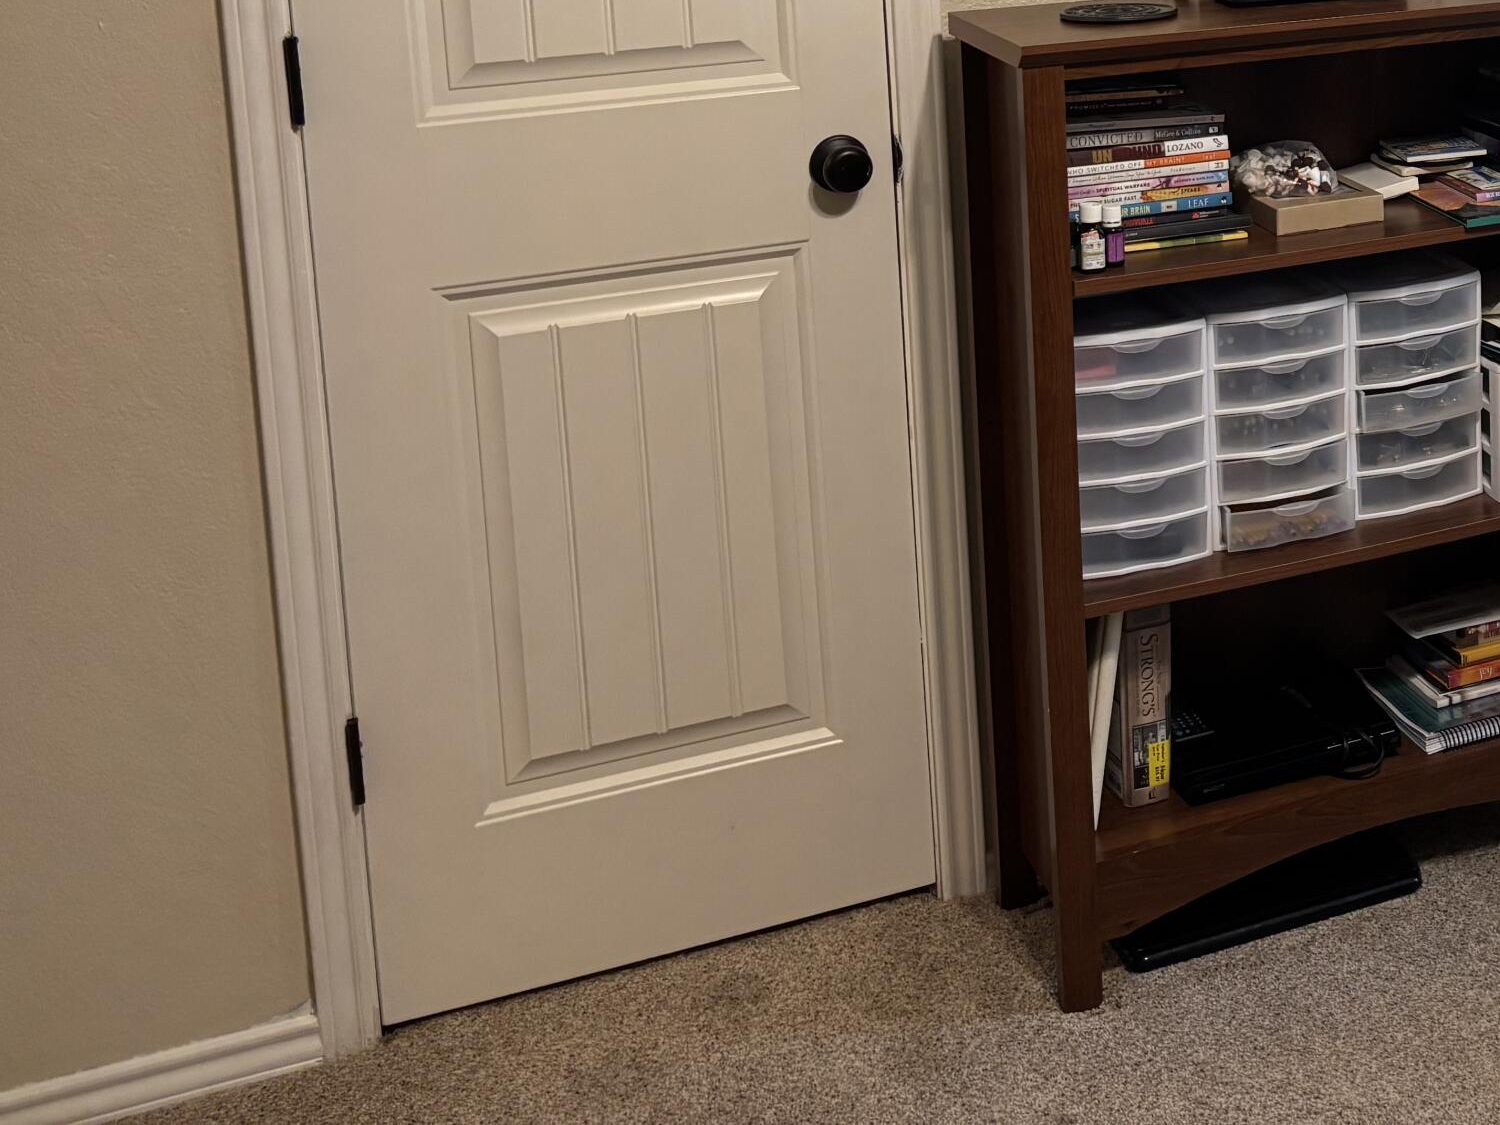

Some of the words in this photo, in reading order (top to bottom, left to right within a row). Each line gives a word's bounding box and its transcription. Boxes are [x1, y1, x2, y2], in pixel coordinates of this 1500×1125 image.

[1070, 132, 1143, 148] CONVICTED
[1167, 142, 1204, 153] LOZANO
[1087, 164, 1125, 173] SWITCHED
[1130, 204, 1151, 215] BRAIN
[1188, 198, 1209, 209] LEAF
[1140, 633, 1159, 718] STRONG'S
